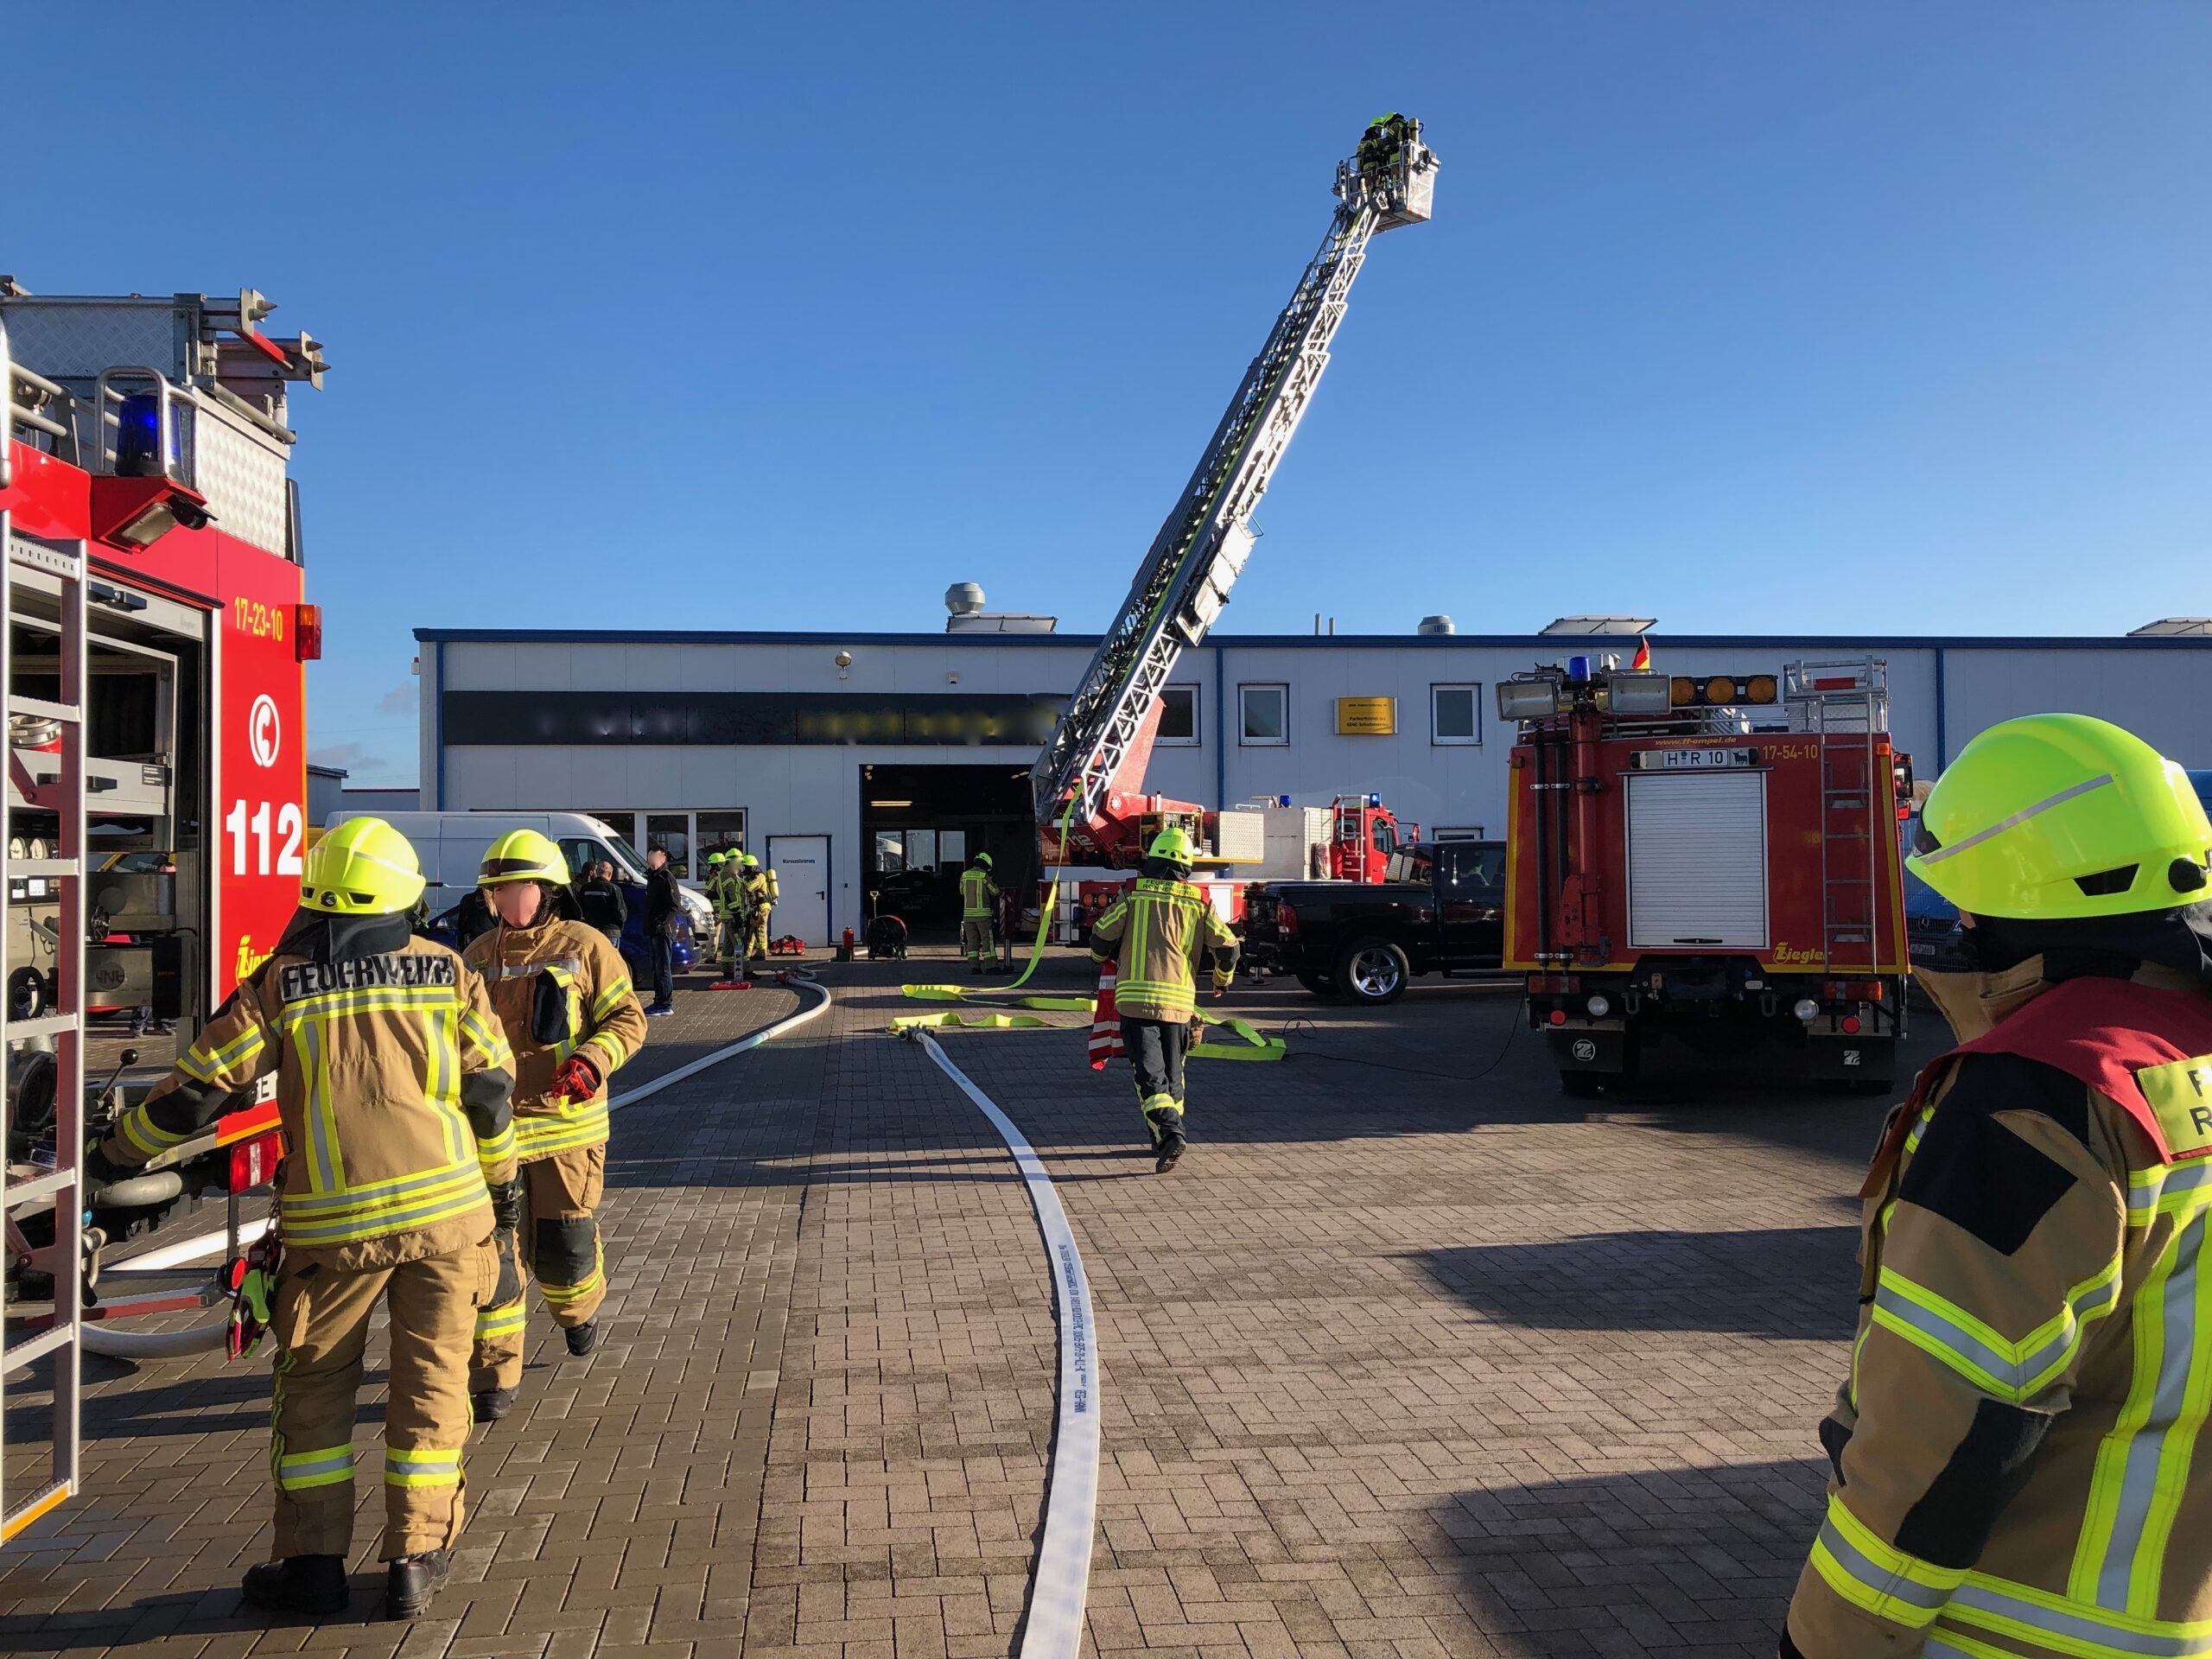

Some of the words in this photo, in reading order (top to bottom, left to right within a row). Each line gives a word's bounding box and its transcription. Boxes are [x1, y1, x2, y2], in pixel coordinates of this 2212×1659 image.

[234, 596, 283, 642] 17-23-10
[1668, 753, 1678, 766] H
[1691, 752, 1700, 765] R
[1708, 751, 1724, 765] 10
[1763, 744, 1818, 760] 17-54-10
[226, 798, 302, 875] 112
[1142, 883, 1195, 896] RONNENBERG
[1146, 879, 1192, 890] FEUERWEHR
[281, 955, 454, 998] FEUERWEHR
